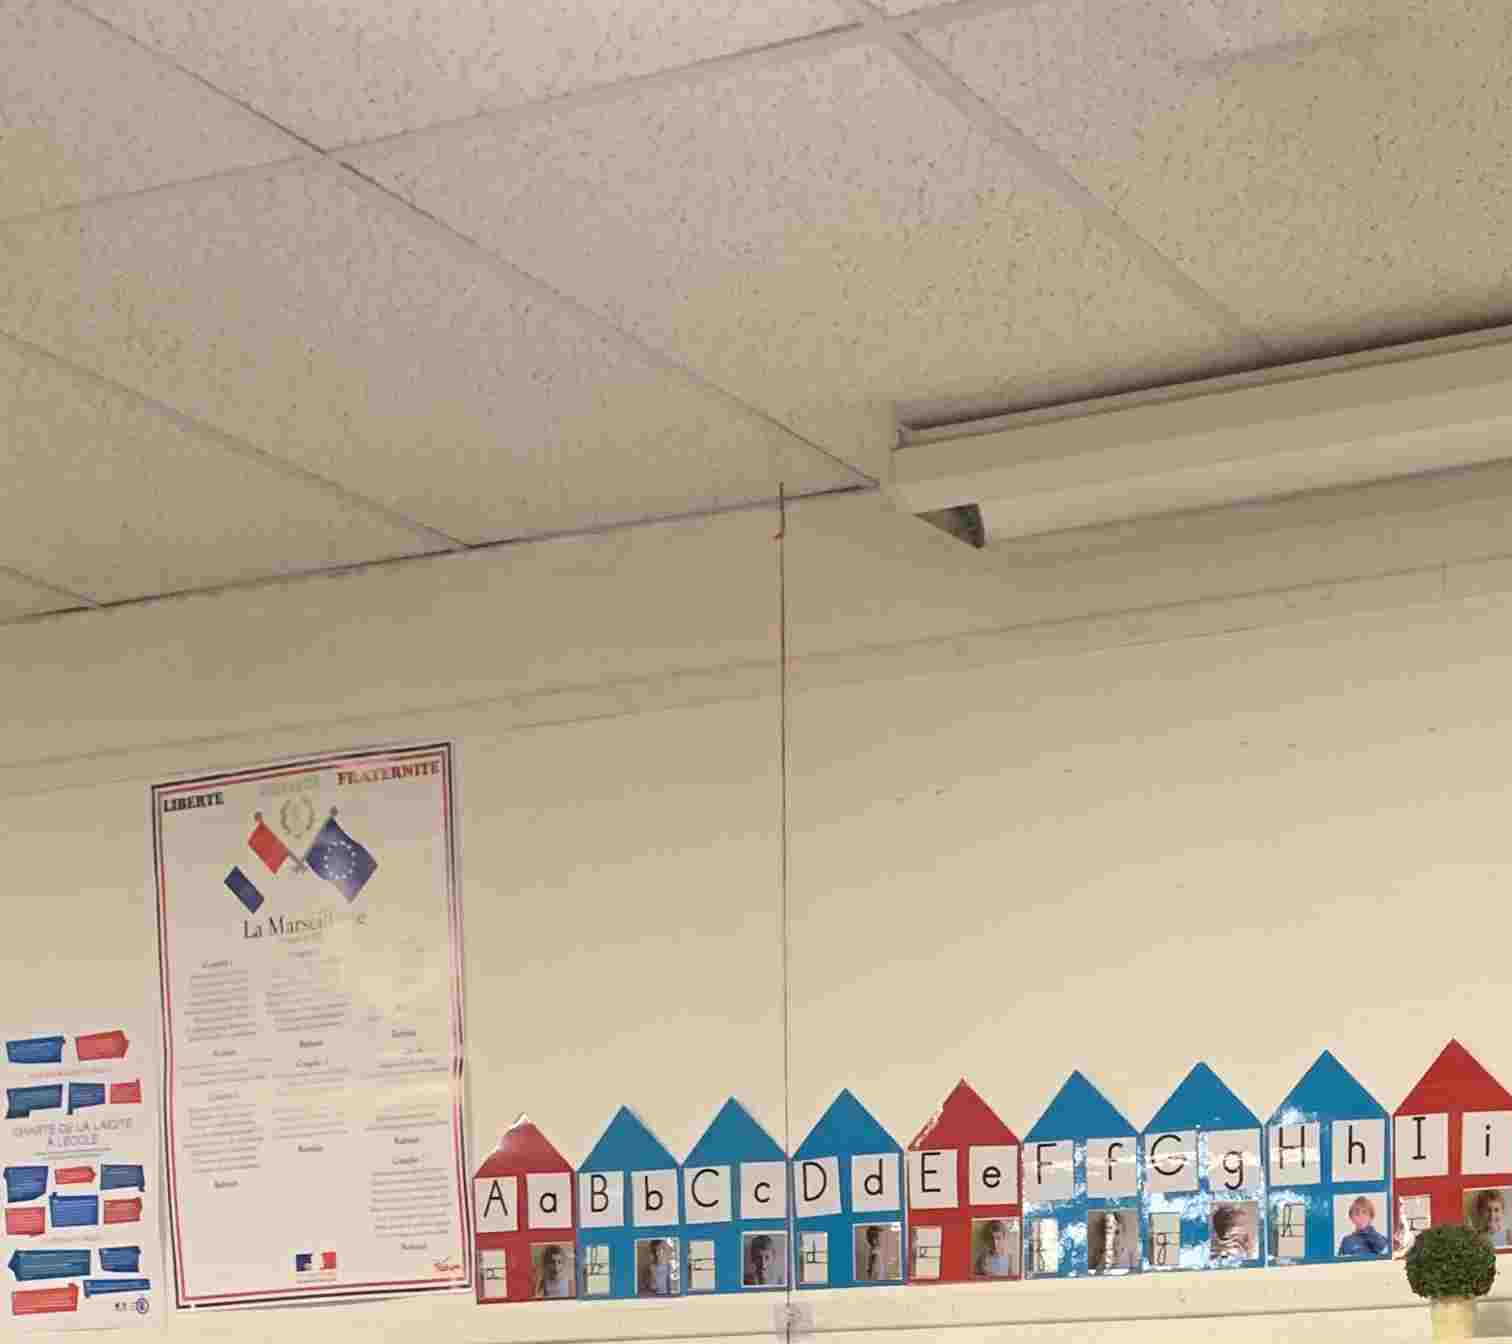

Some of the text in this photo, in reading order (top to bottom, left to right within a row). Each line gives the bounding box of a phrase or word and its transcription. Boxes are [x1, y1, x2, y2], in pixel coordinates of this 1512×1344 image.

[243, 919, 263, 938] La
[1280, 1126, 1365, 1169] H h
[1411, 1116, 1492, 1160] I i
[802, 1159, 885, 1201] D d
[922, 1152, 1002, 1193] E e
[1037, 1143, 1122, 1184] F f
[1223, 1151, 1243, 1190] g
[484, 1180, 558, 1217] A a
[590, 1174, 664, 1213] B b
[691, 1168, 771, 1208] C c
